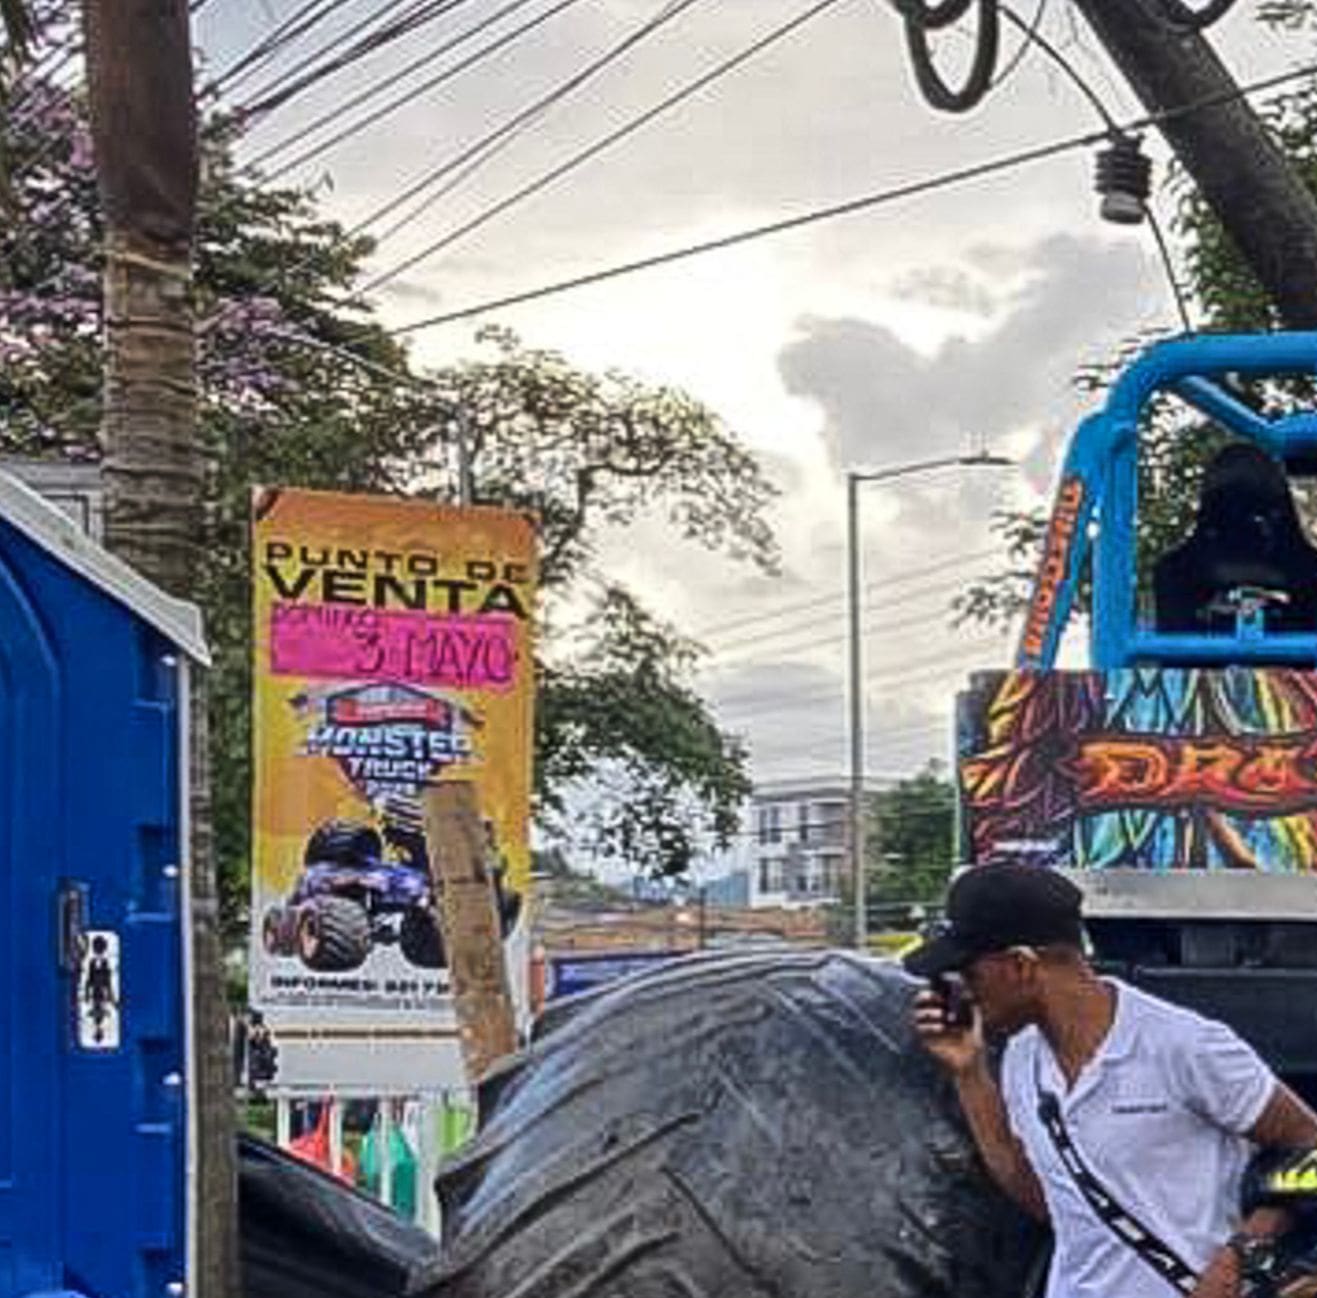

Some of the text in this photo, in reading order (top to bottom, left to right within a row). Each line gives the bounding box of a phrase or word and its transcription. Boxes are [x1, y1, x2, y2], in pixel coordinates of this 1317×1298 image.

[265, 541, 529, 583] PUNTO DE
[265, 565, 528, 618] VENTA
[354, 630, 511, 684] 3 MAYO
[348, 757, 433, 780] TRUCK
